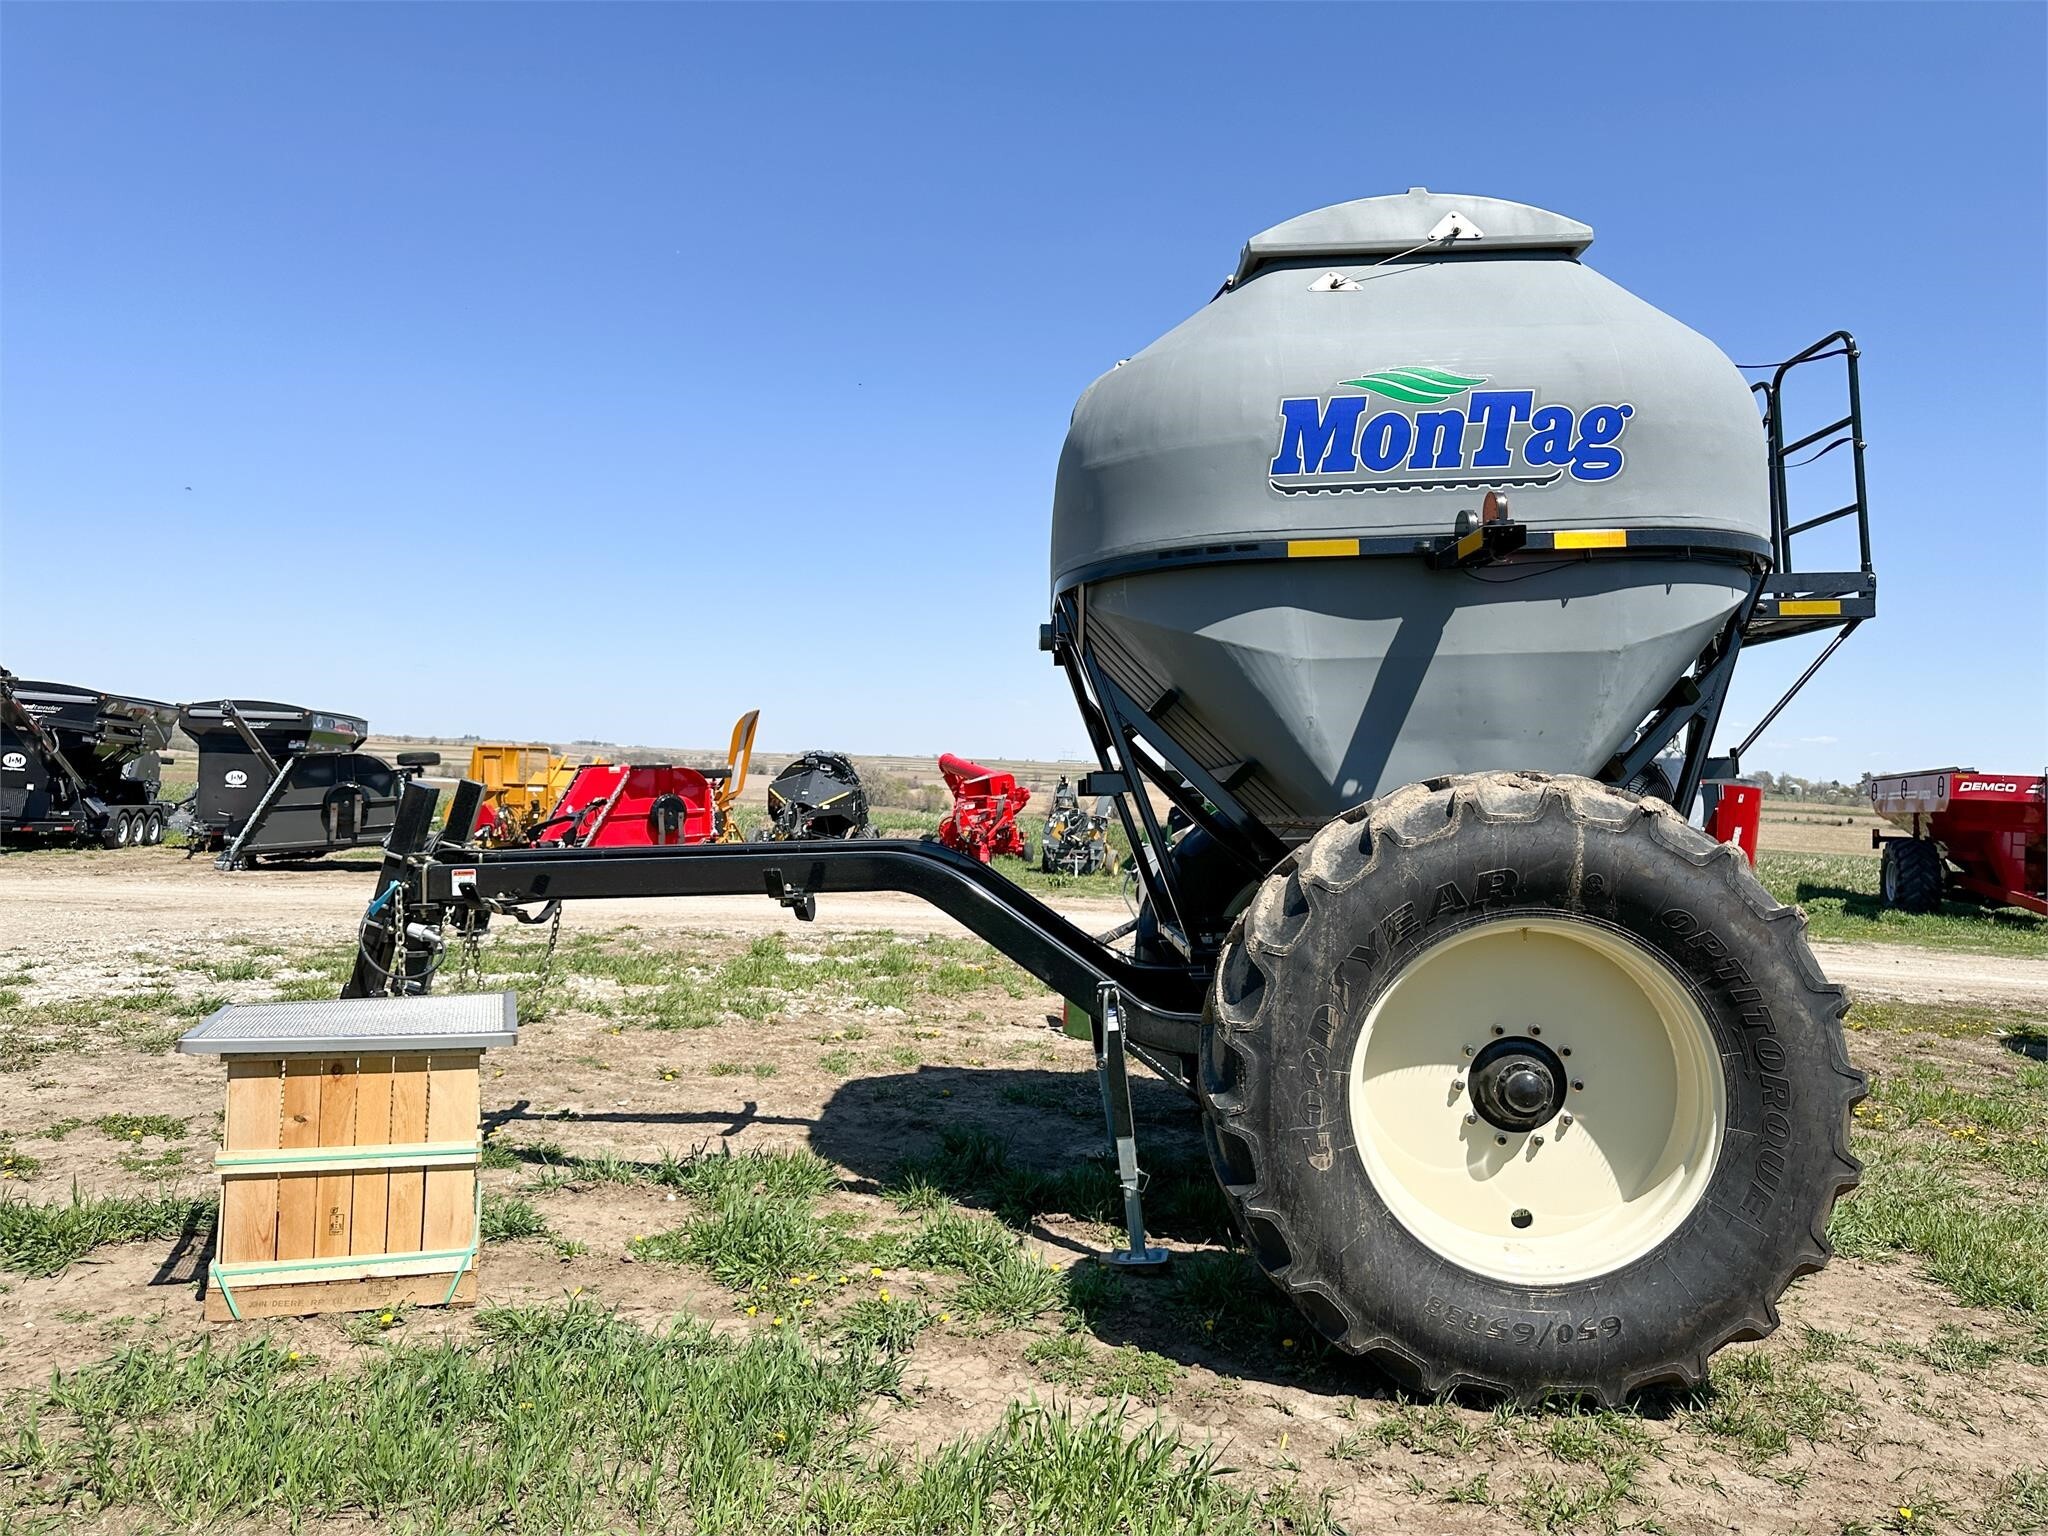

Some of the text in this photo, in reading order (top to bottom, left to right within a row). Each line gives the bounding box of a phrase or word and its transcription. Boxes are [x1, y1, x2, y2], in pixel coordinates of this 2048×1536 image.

[1269, 388, 1634, 482] MonTag
[1958, 781, 2017, 793] DEMCO
[1660, 907, 1792, 1224] OPTITORQUE
